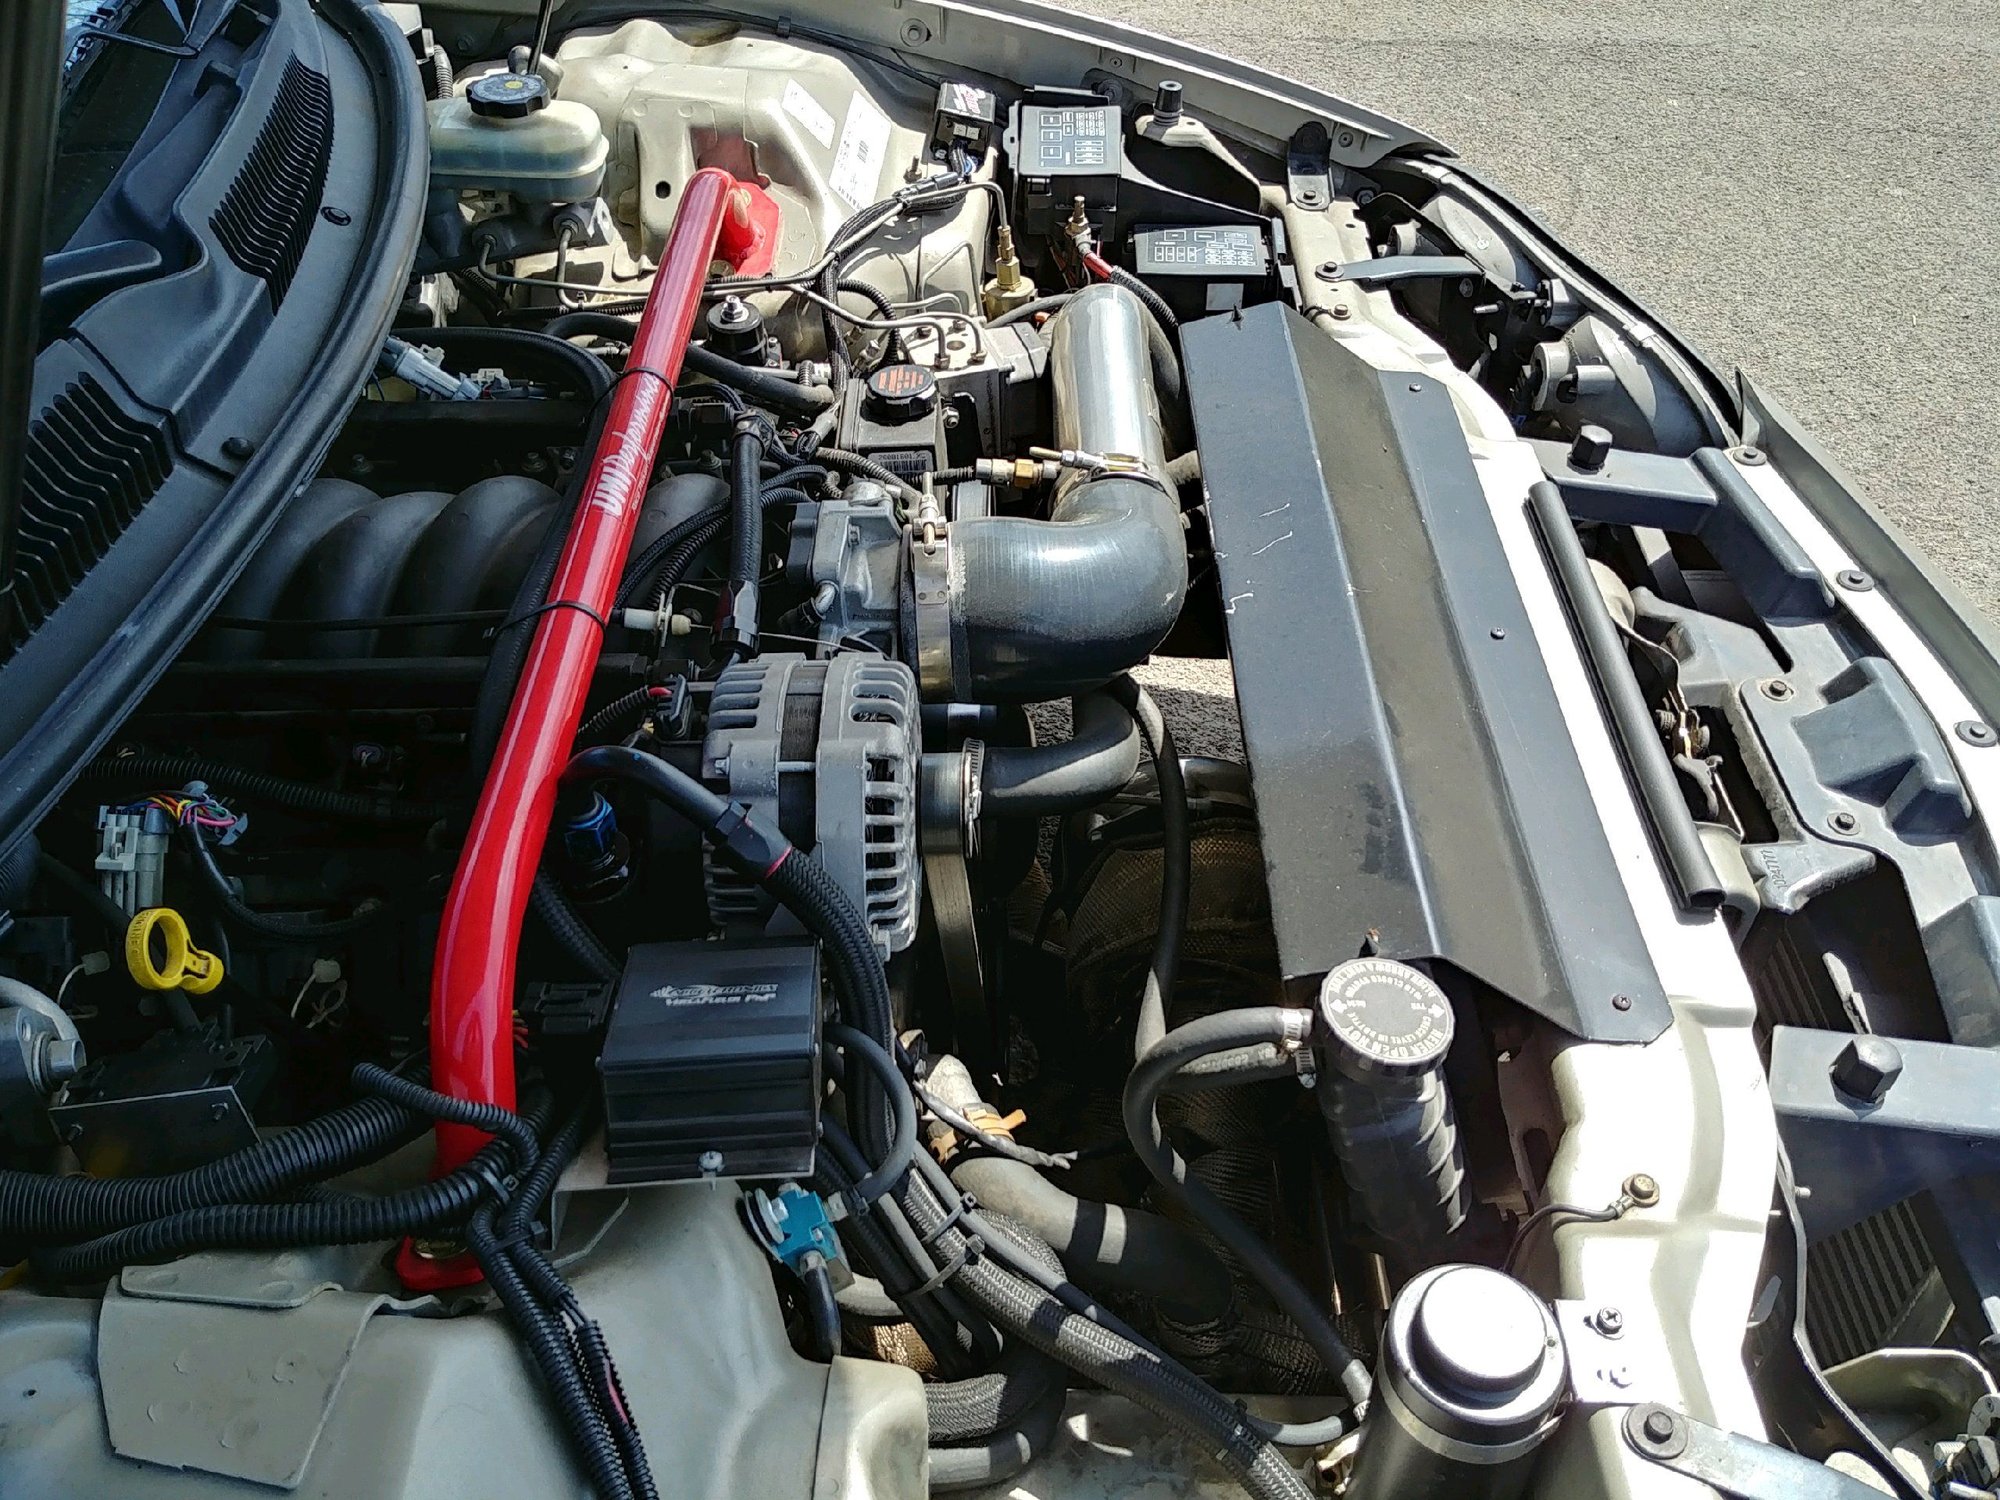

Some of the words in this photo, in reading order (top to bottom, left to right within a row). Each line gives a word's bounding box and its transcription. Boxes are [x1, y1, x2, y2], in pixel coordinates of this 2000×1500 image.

[592, 464, 631, 514] UMI
[1371, 1041, 1409, 1057] OPEN
[1412, 1029, 1441, 1055] NEVER
